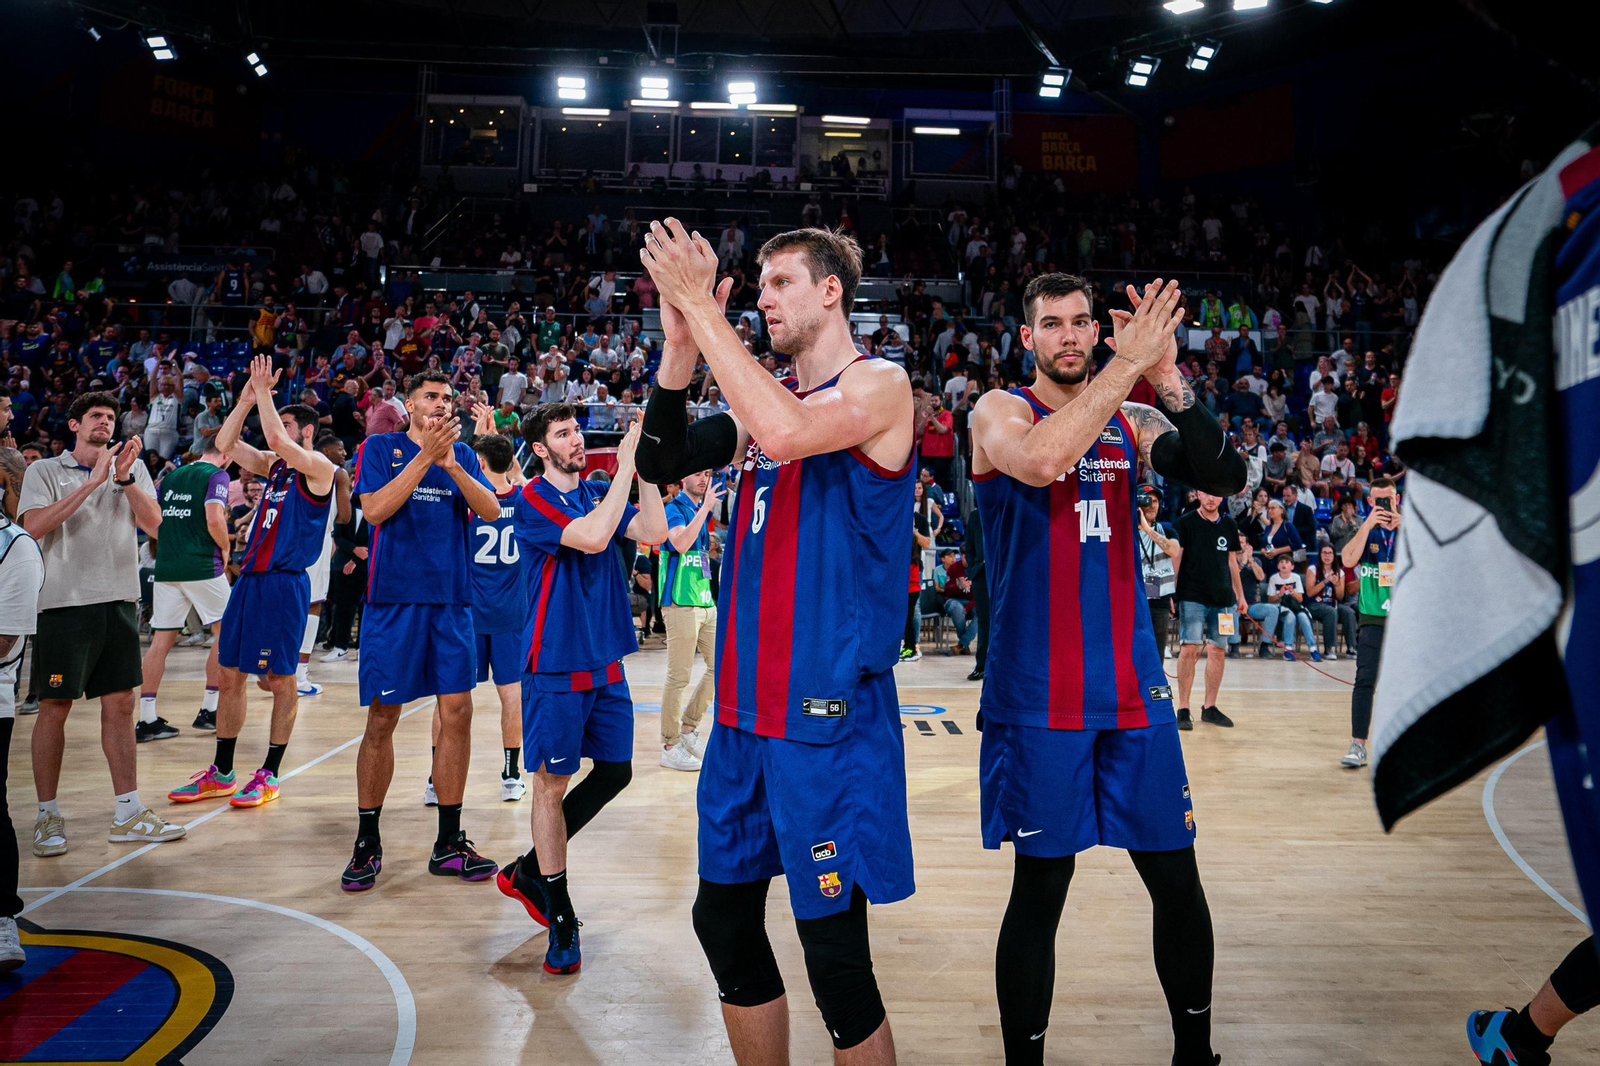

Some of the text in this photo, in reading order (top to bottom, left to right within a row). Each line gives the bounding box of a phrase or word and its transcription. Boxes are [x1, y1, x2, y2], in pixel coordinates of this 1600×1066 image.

[153, 74, 214, 105] FORÇA
[150, 98, 214, 129] BARÇA
[1041, 142, 1081, 155] BARÇA
[1041, 154, 1098, 174] BARÇA
[262, 508, 278, 529] 10
[752, 486, 769, 534] 6
[1074, 499, 1112, 543] 14
[474, 525, 520, 564] 20
[700, 590, 711, 604] 10
[1381, 599, 1391, 613] 4
[830, 703, 840, 712] 56
[815, 849, 832, 859] acb
